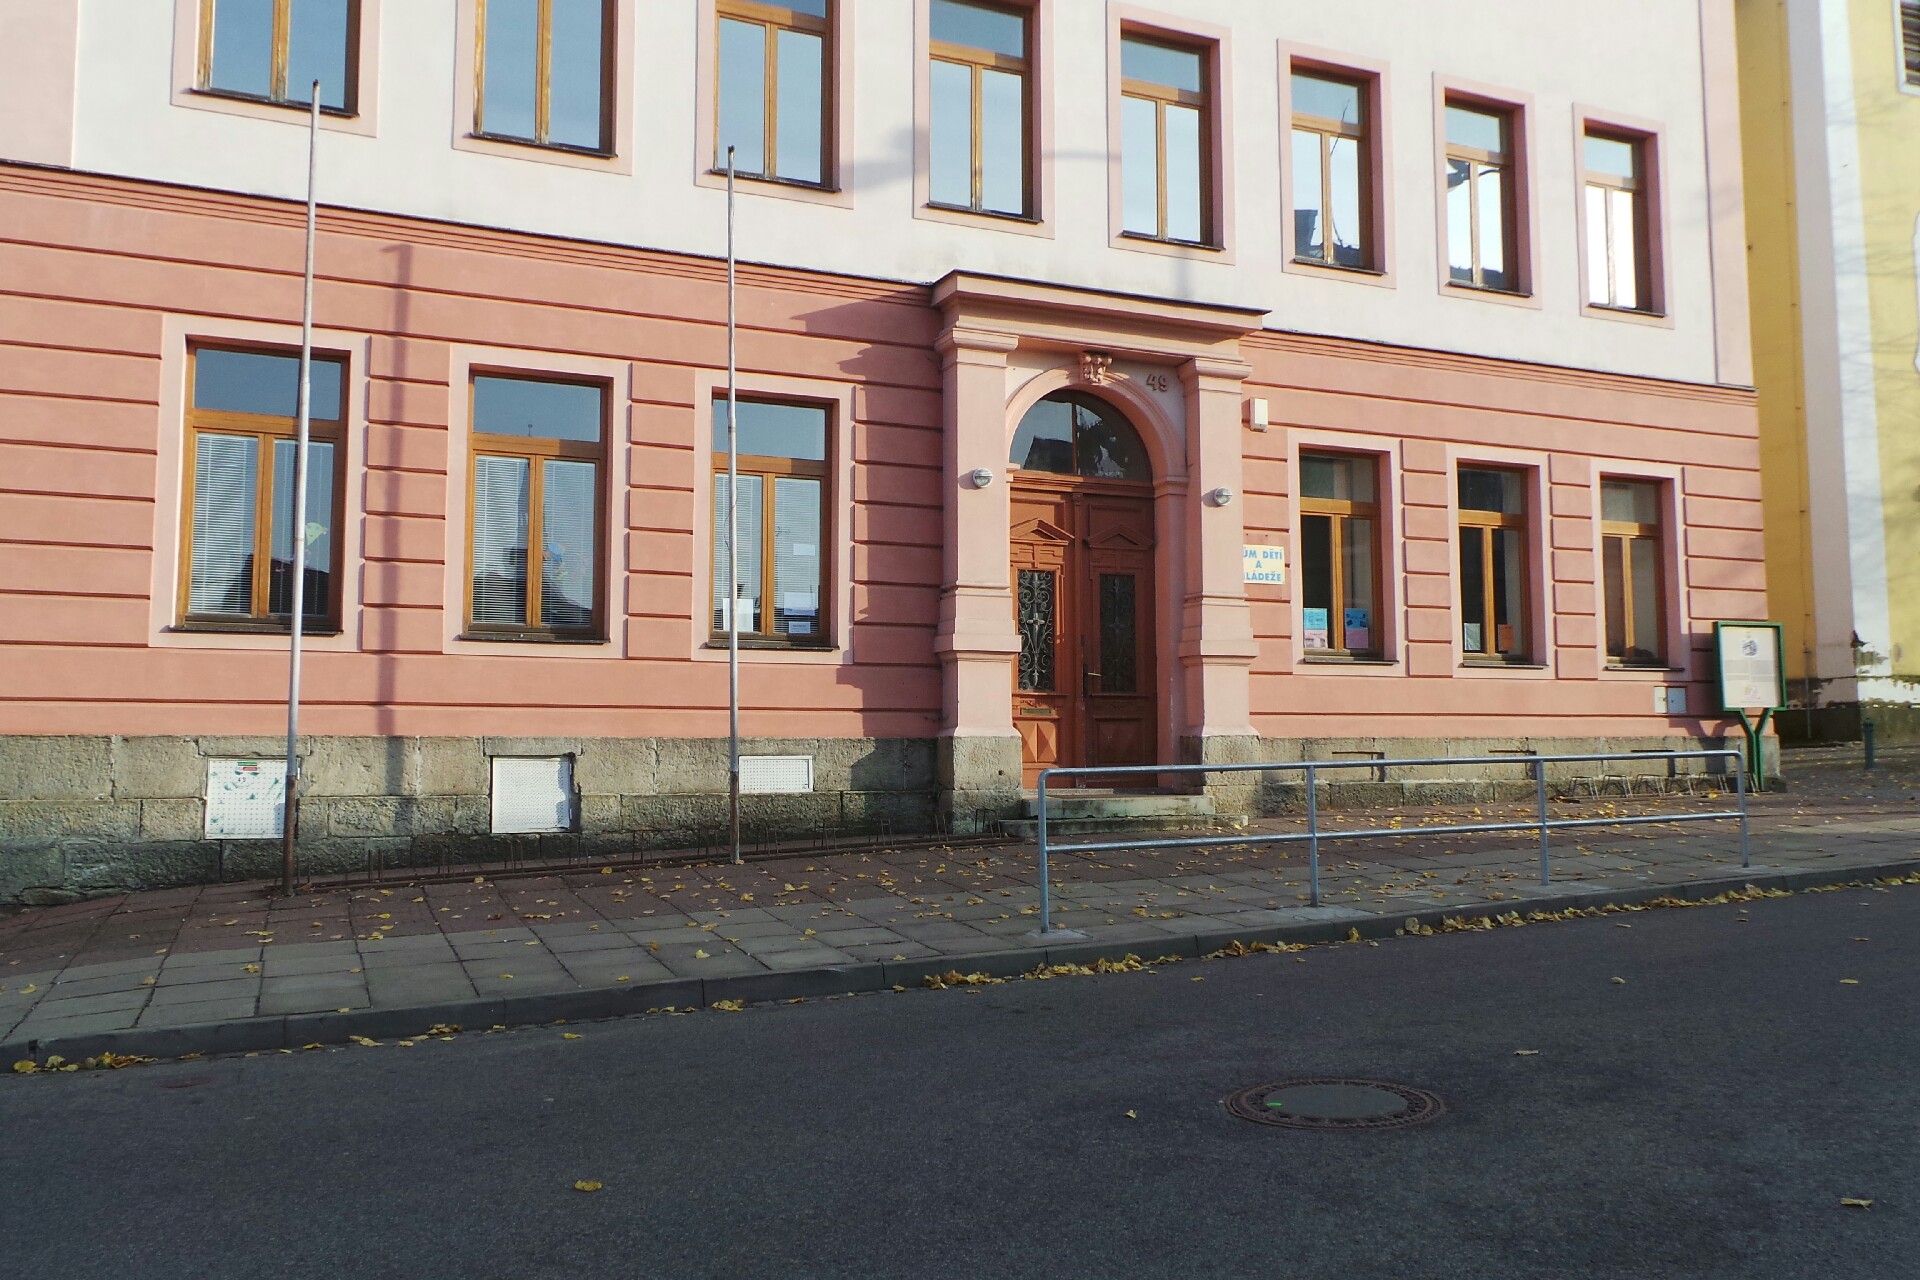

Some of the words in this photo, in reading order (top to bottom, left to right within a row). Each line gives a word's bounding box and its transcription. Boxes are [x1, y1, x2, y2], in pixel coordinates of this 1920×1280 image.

[1146, 374, 1167, 392] 49
[1262, 548, 1282, 559] DĚTÍ
[1255, 560, 1262, 568] A
[1243, 570, 1281, 581] LÁDEŽE
